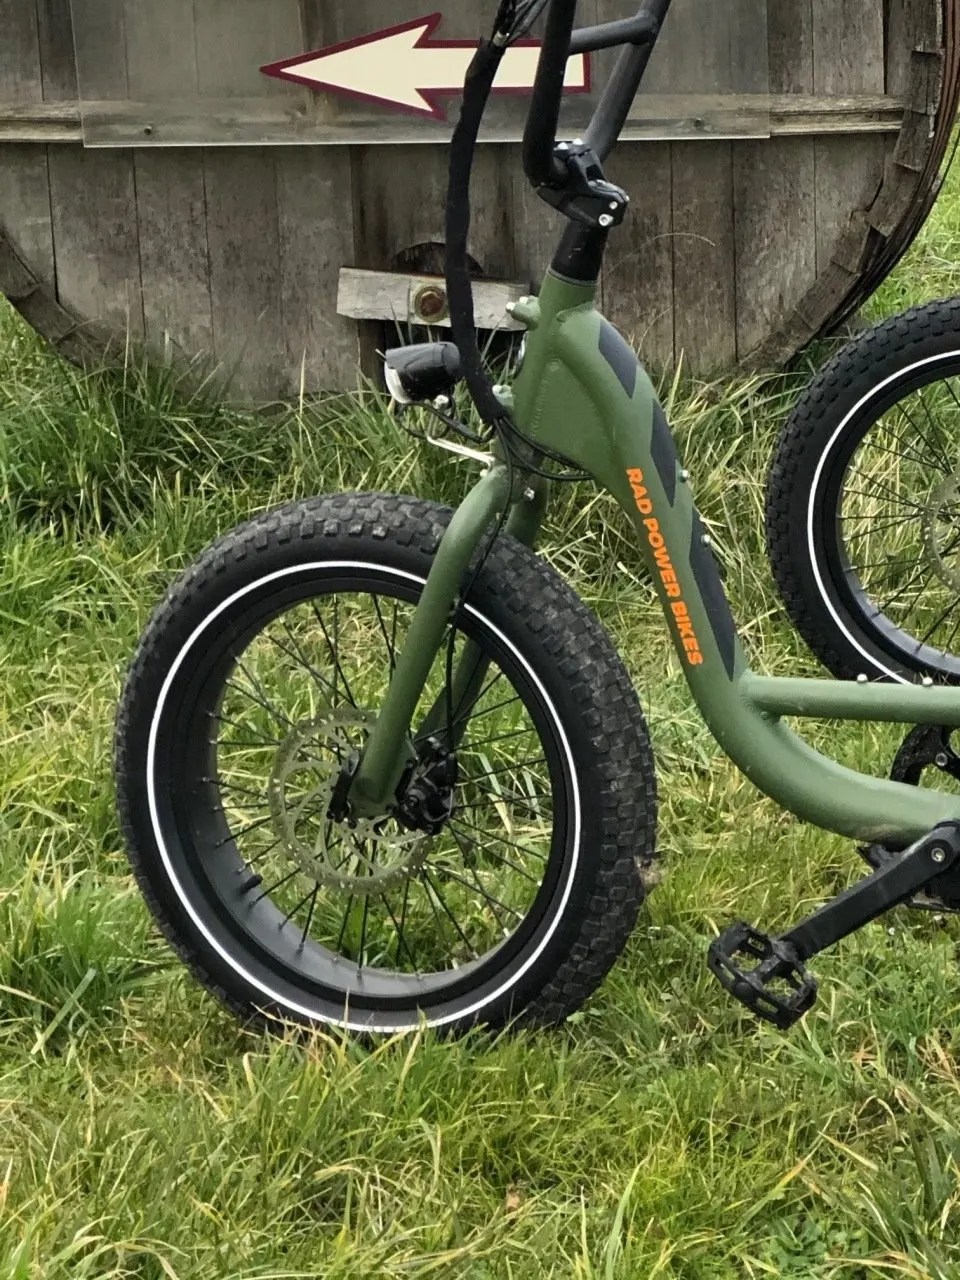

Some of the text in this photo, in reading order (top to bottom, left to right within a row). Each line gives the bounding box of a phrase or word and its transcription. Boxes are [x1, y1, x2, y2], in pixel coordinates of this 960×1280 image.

[625, 467, 704, 666] RAD POWER BIKES
